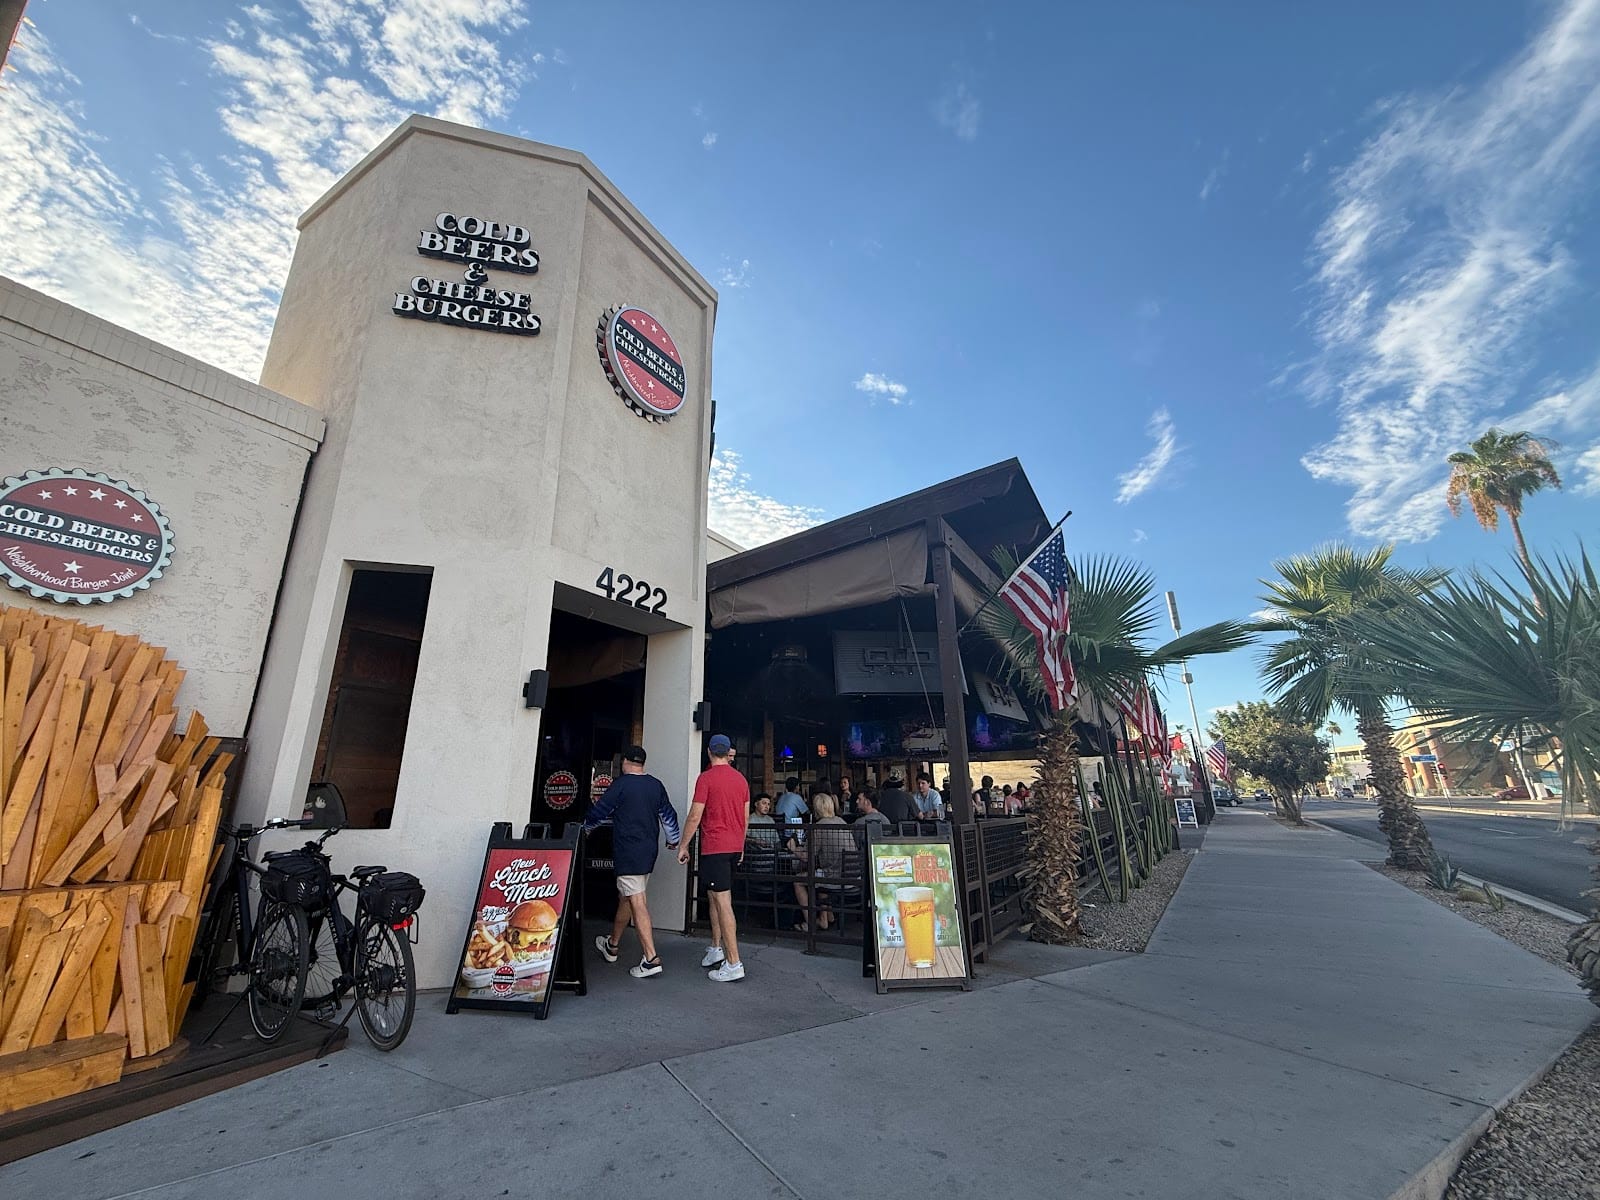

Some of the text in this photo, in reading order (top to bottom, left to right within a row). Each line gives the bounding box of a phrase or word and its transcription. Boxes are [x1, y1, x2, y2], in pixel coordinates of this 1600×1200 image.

[435, 212, 531, 246] COLD
[419, 230, 539, 269] BEERS
[464, 262, 487, 283] &
[394, 292, 541, 331] BURGERS
[411, 276, 531, 311] CHEESE
[615, 335, 683, 393] CHEESEBURGERS
[616, 323, 684, 383] COLD BEERS &
[0, 505, 159, 550] COLD BEERS &
[4, 546, 137, 590] Neighborhood Burger Joint
[596, 566, 667, 618] 4222
[490, 863, 552, 891] Lunch
[511, 858, 536, 872] New
[504, 883, 559, 904] Menu
